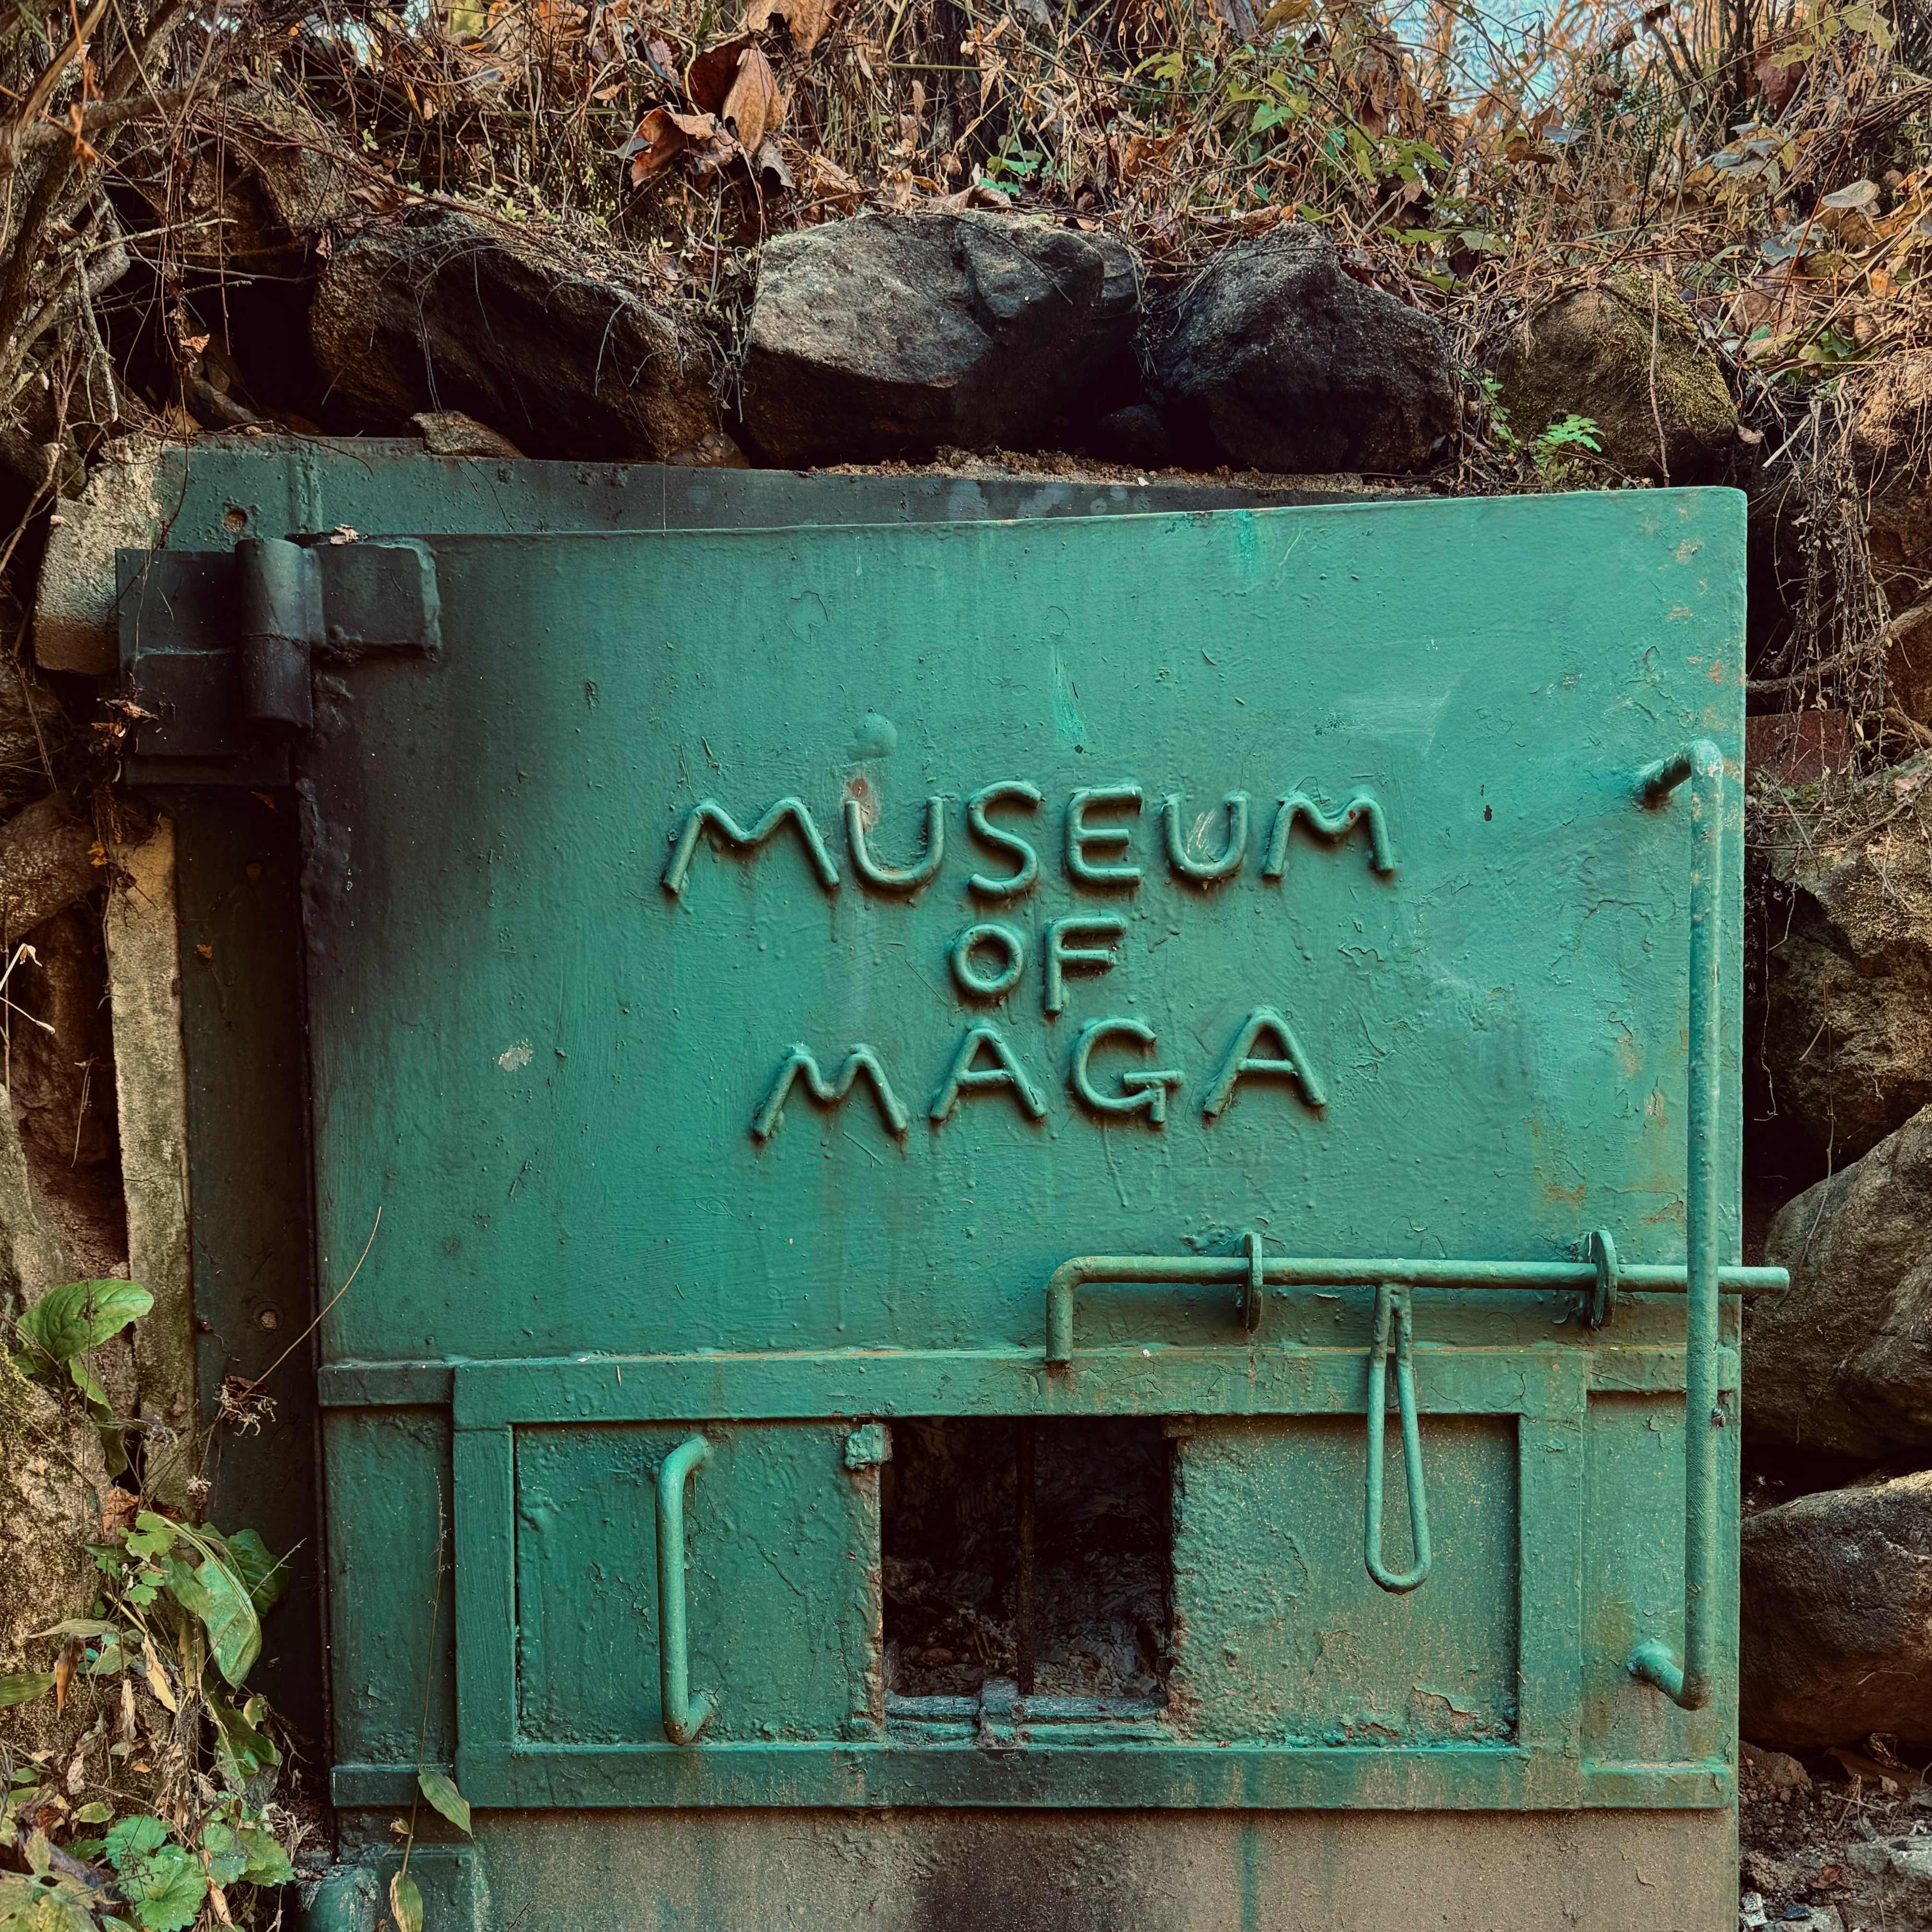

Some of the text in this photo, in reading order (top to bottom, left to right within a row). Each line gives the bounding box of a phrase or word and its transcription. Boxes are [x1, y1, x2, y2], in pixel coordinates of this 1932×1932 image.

[663, 780, 1396, 898] MUSEUM
[949, 913, 1126, 1015] OF
[753, 1007, 1328, 1141] MAGA
